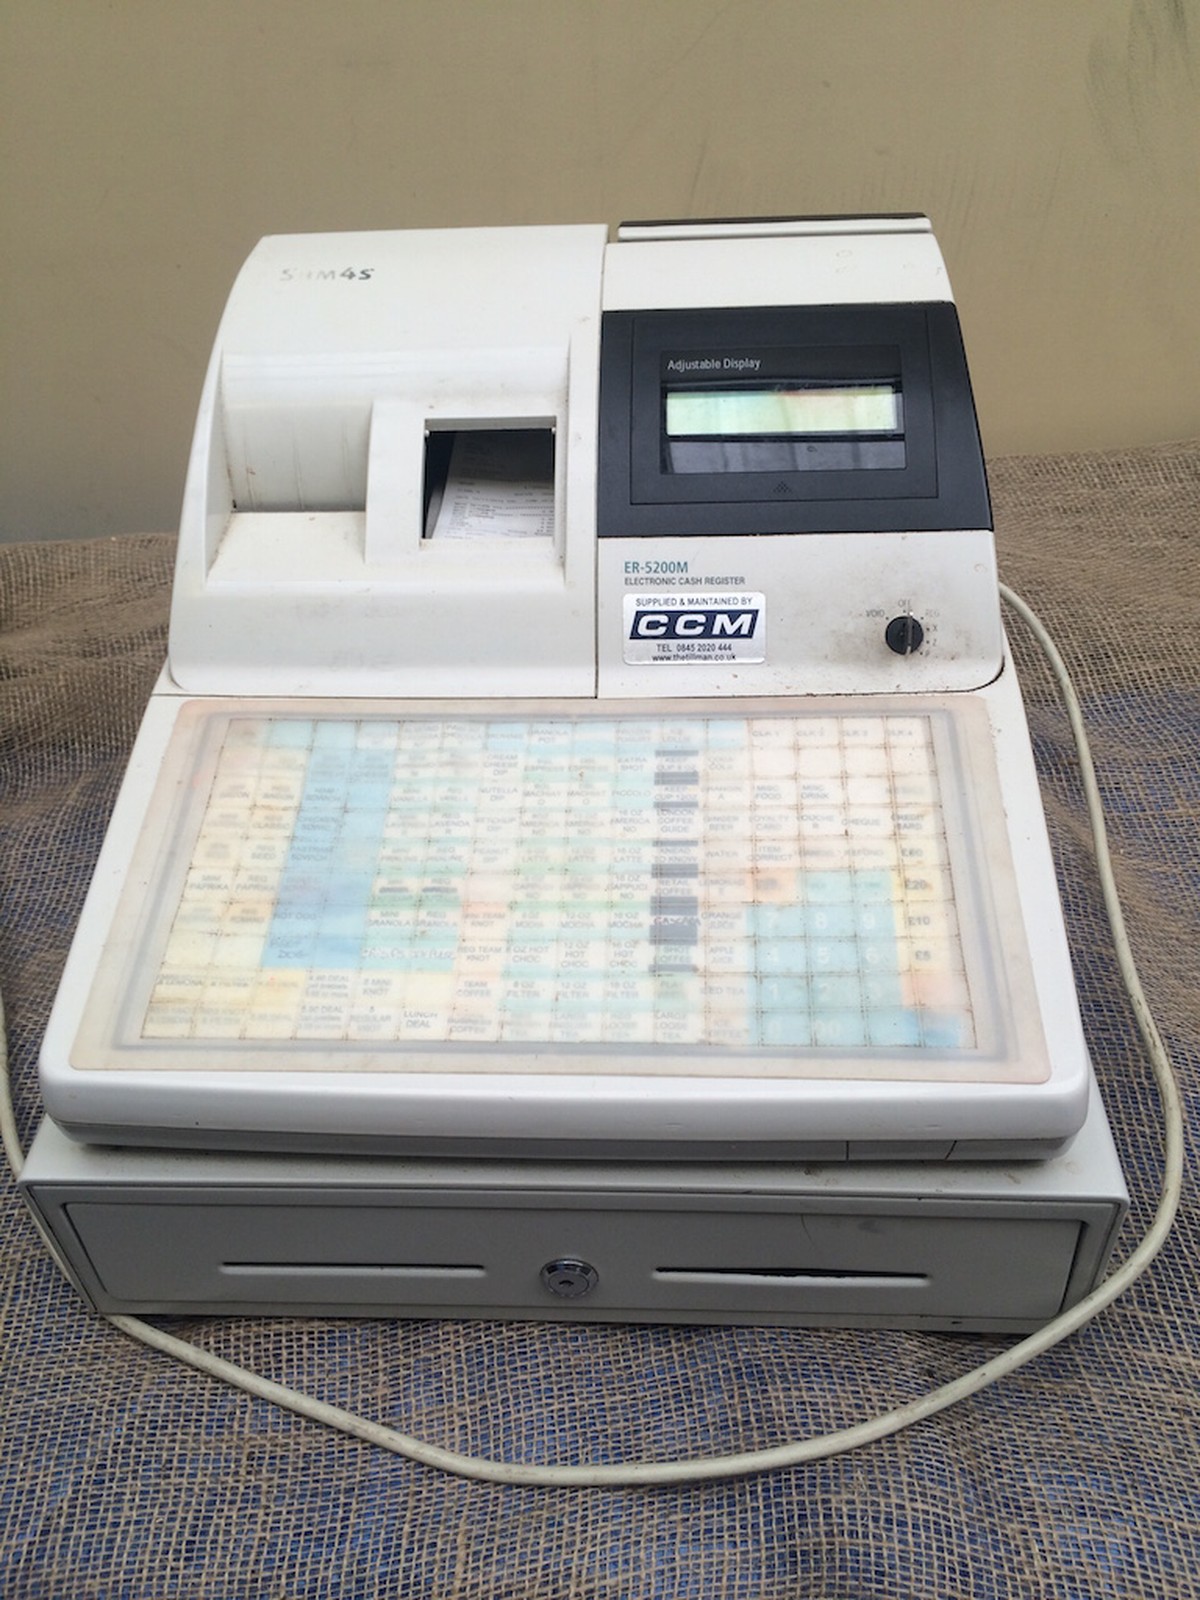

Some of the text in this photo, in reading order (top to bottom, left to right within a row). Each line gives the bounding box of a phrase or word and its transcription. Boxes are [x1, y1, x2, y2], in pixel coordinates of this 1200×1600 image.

[667, 358, 761, 372] Adjustable Display
[624, 561, 689, 574] ER-5200M
[624, 576, 746, 586] ELECTRONIC CASH REGISTER
[635, 597, 753, 607] SUPPLIED & MAINTAINED BY
[636, 613, 753, 637] CCM
[656, 643, 732, 652] TEL 0845 2020 444
[651, 653, 736, 662] www.thetillman.co.uk
